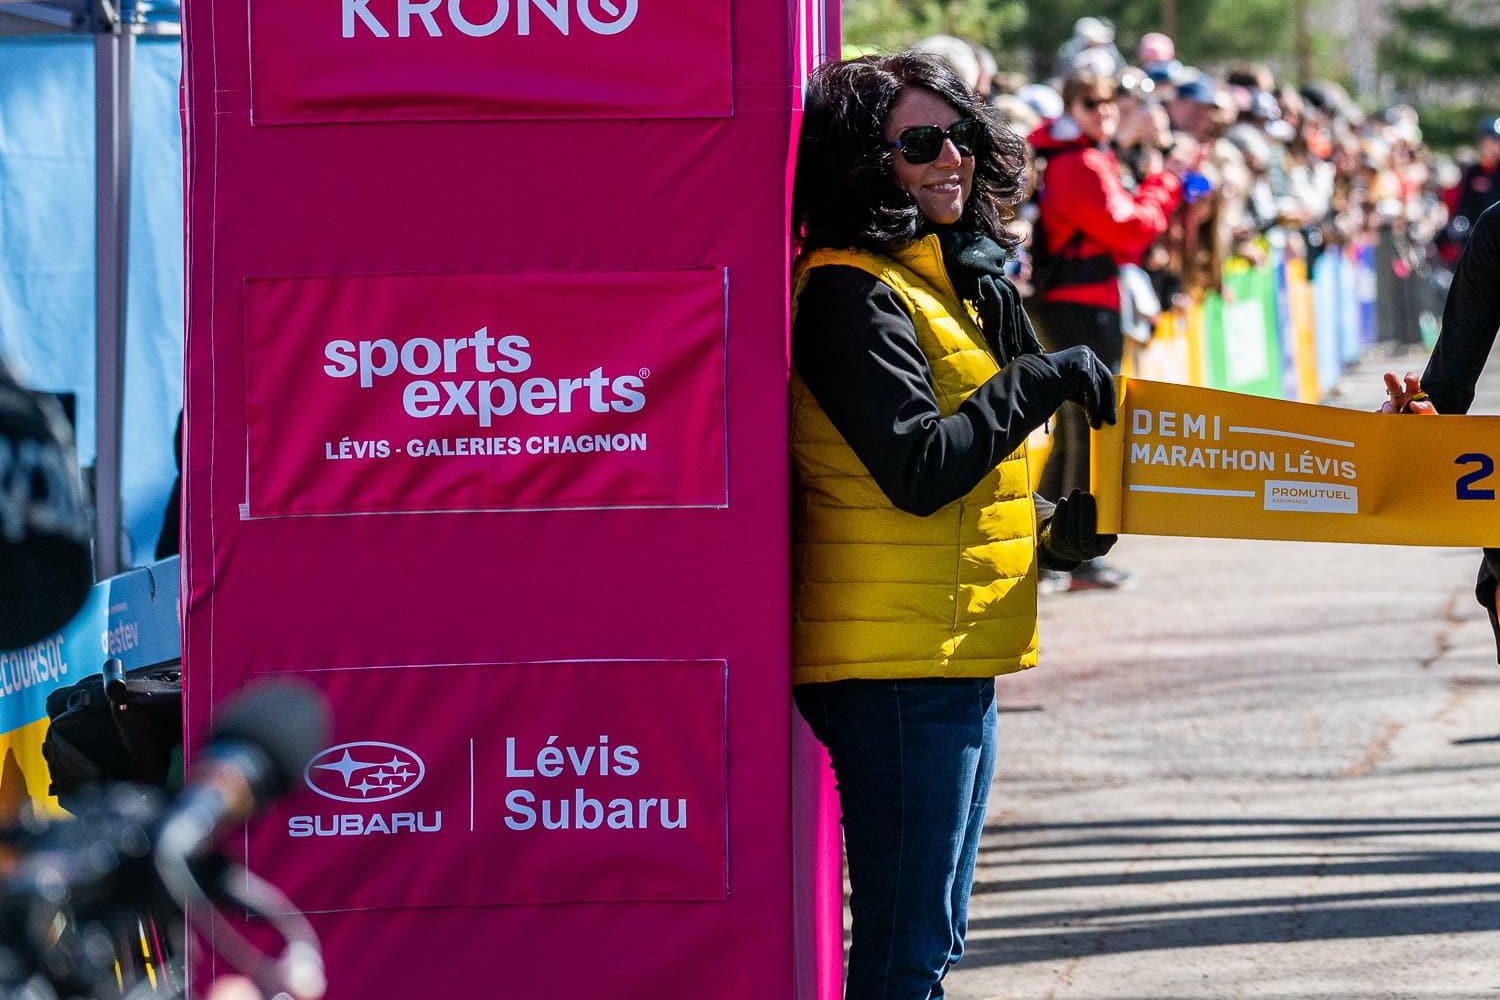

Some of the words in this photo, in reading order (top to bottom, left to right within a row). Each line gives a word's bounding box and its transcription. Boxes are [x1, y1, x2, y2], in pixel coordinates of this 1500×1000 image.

[323, 325, 533, 389] sports
[1132, 409, 1222, 442] DEMI
[325, 436, 391, 461] LÉVIS
[406, 436, 522, 458] GALERIES
[526, 432, 648, 455] CHAGNON
[1130, 442, 1276, 472] MARATHON
[1284, 450, 1358, 480] LÉVIS
[1271, 486, 1352, 501] PROMUTUEL
[505, 734, 641, 778] Lévis
[287, 810, 443, 838] SUBARU
[503, 788, 688, 832] Subaru
